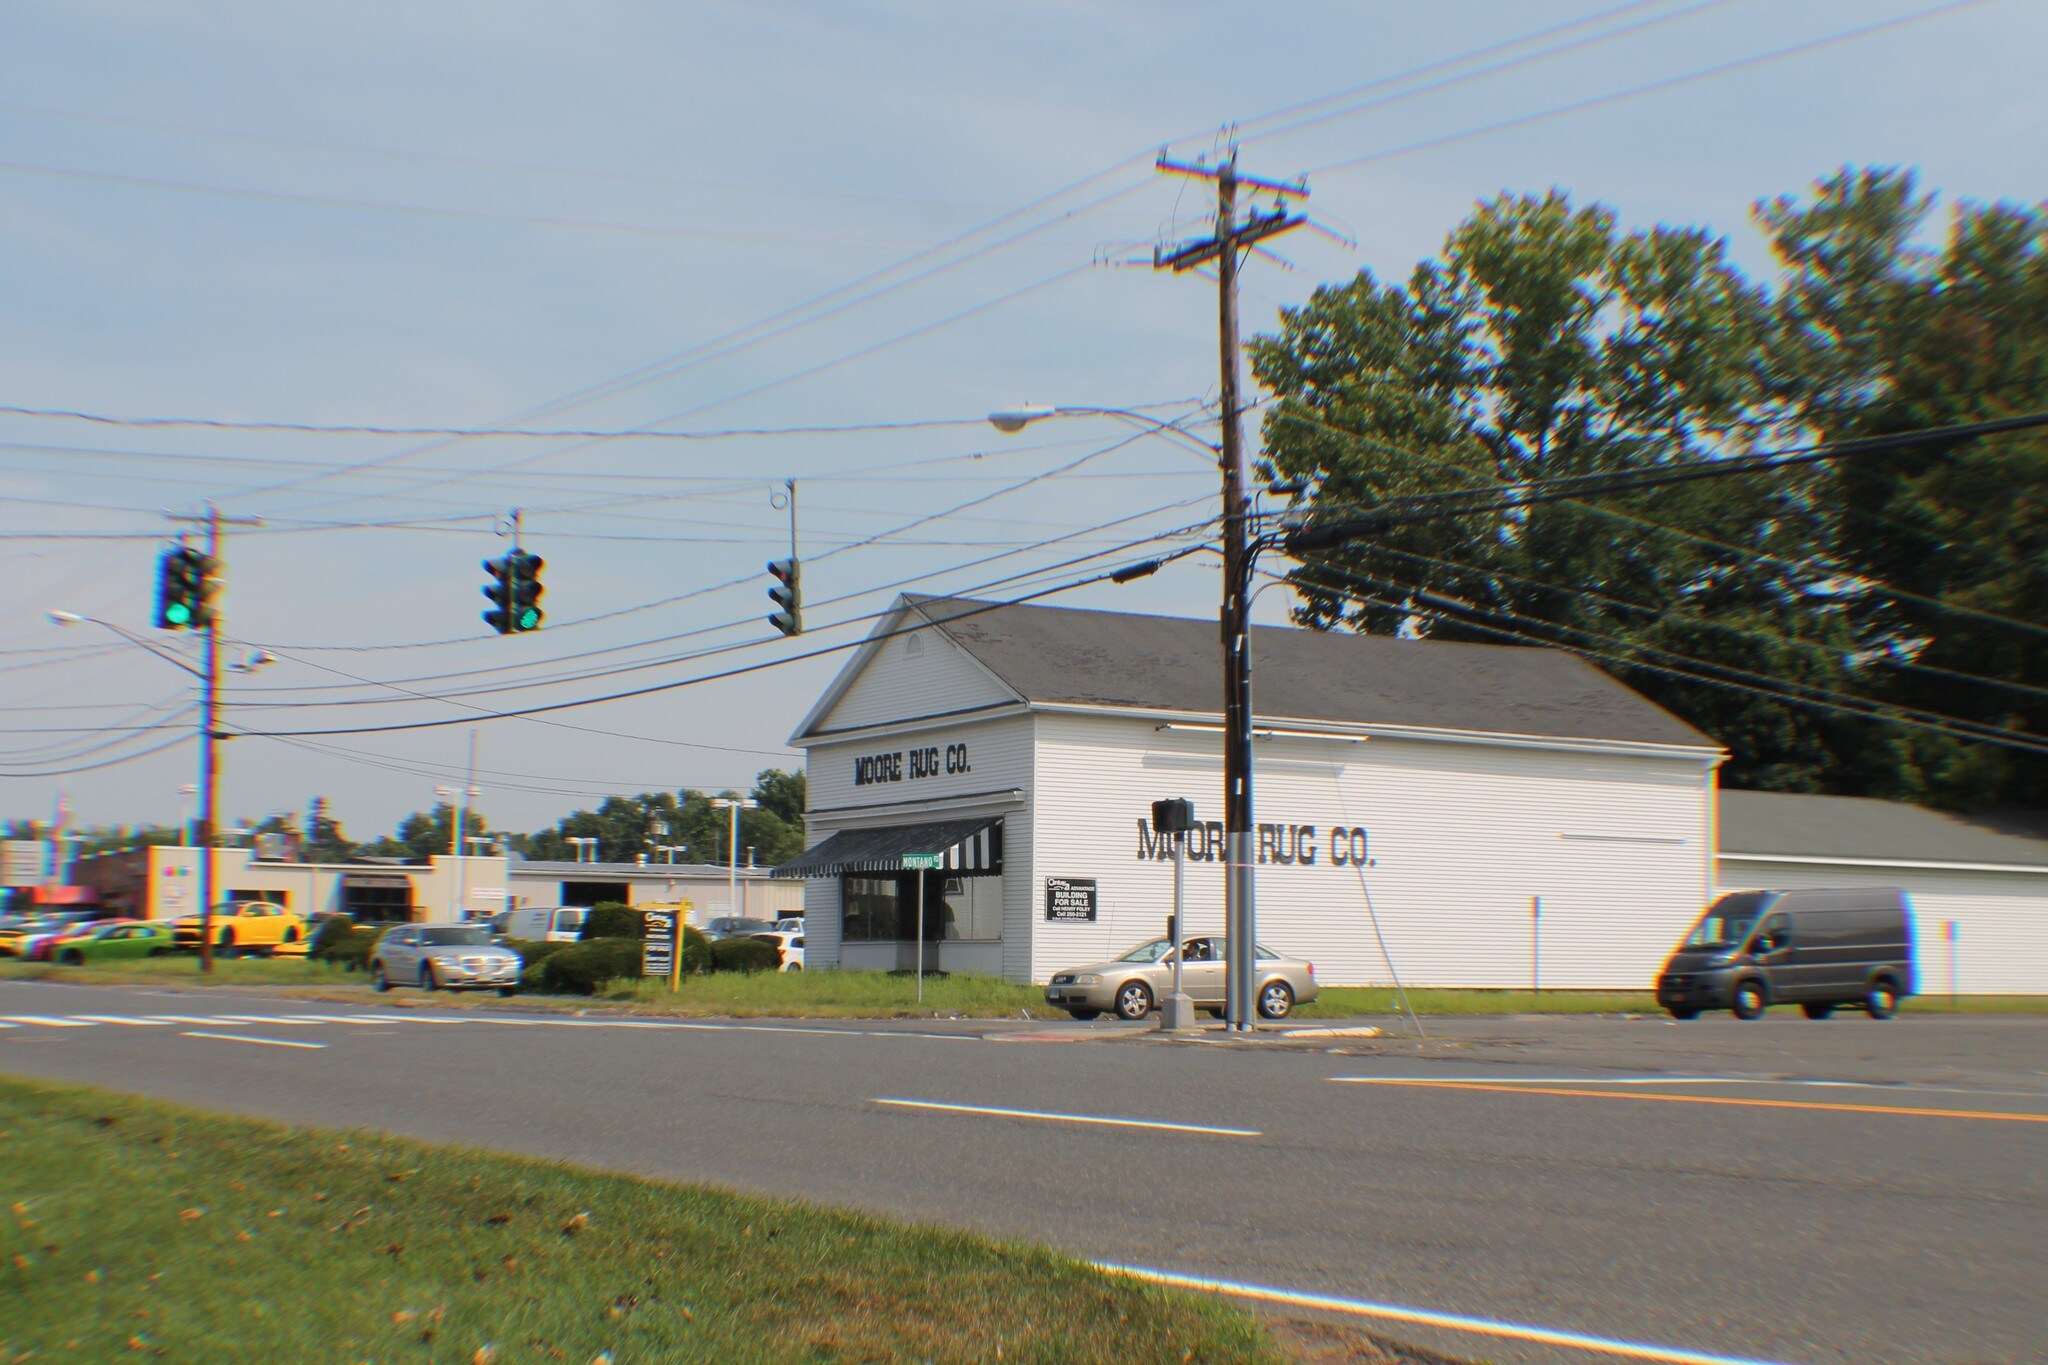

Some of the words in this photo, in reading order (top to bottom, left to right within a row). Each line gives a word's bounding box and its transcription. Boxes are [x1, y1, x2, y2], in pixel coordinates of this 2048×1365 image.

[855, 752, 902, 785] MOORE
[909, 747, 939, 779] RUG
[946, 743, 971, 774] CO.
[1258, 823, 1317, 865] RUG
[1331, 826, 1377, 867] CO.
[902, 856, 933, 867] MONTANO
[1055, 891, 1088, 899] BUILDING
[1054, 898, 1069, 906] FOR
[1070, 898, 1089, 906] SALE
